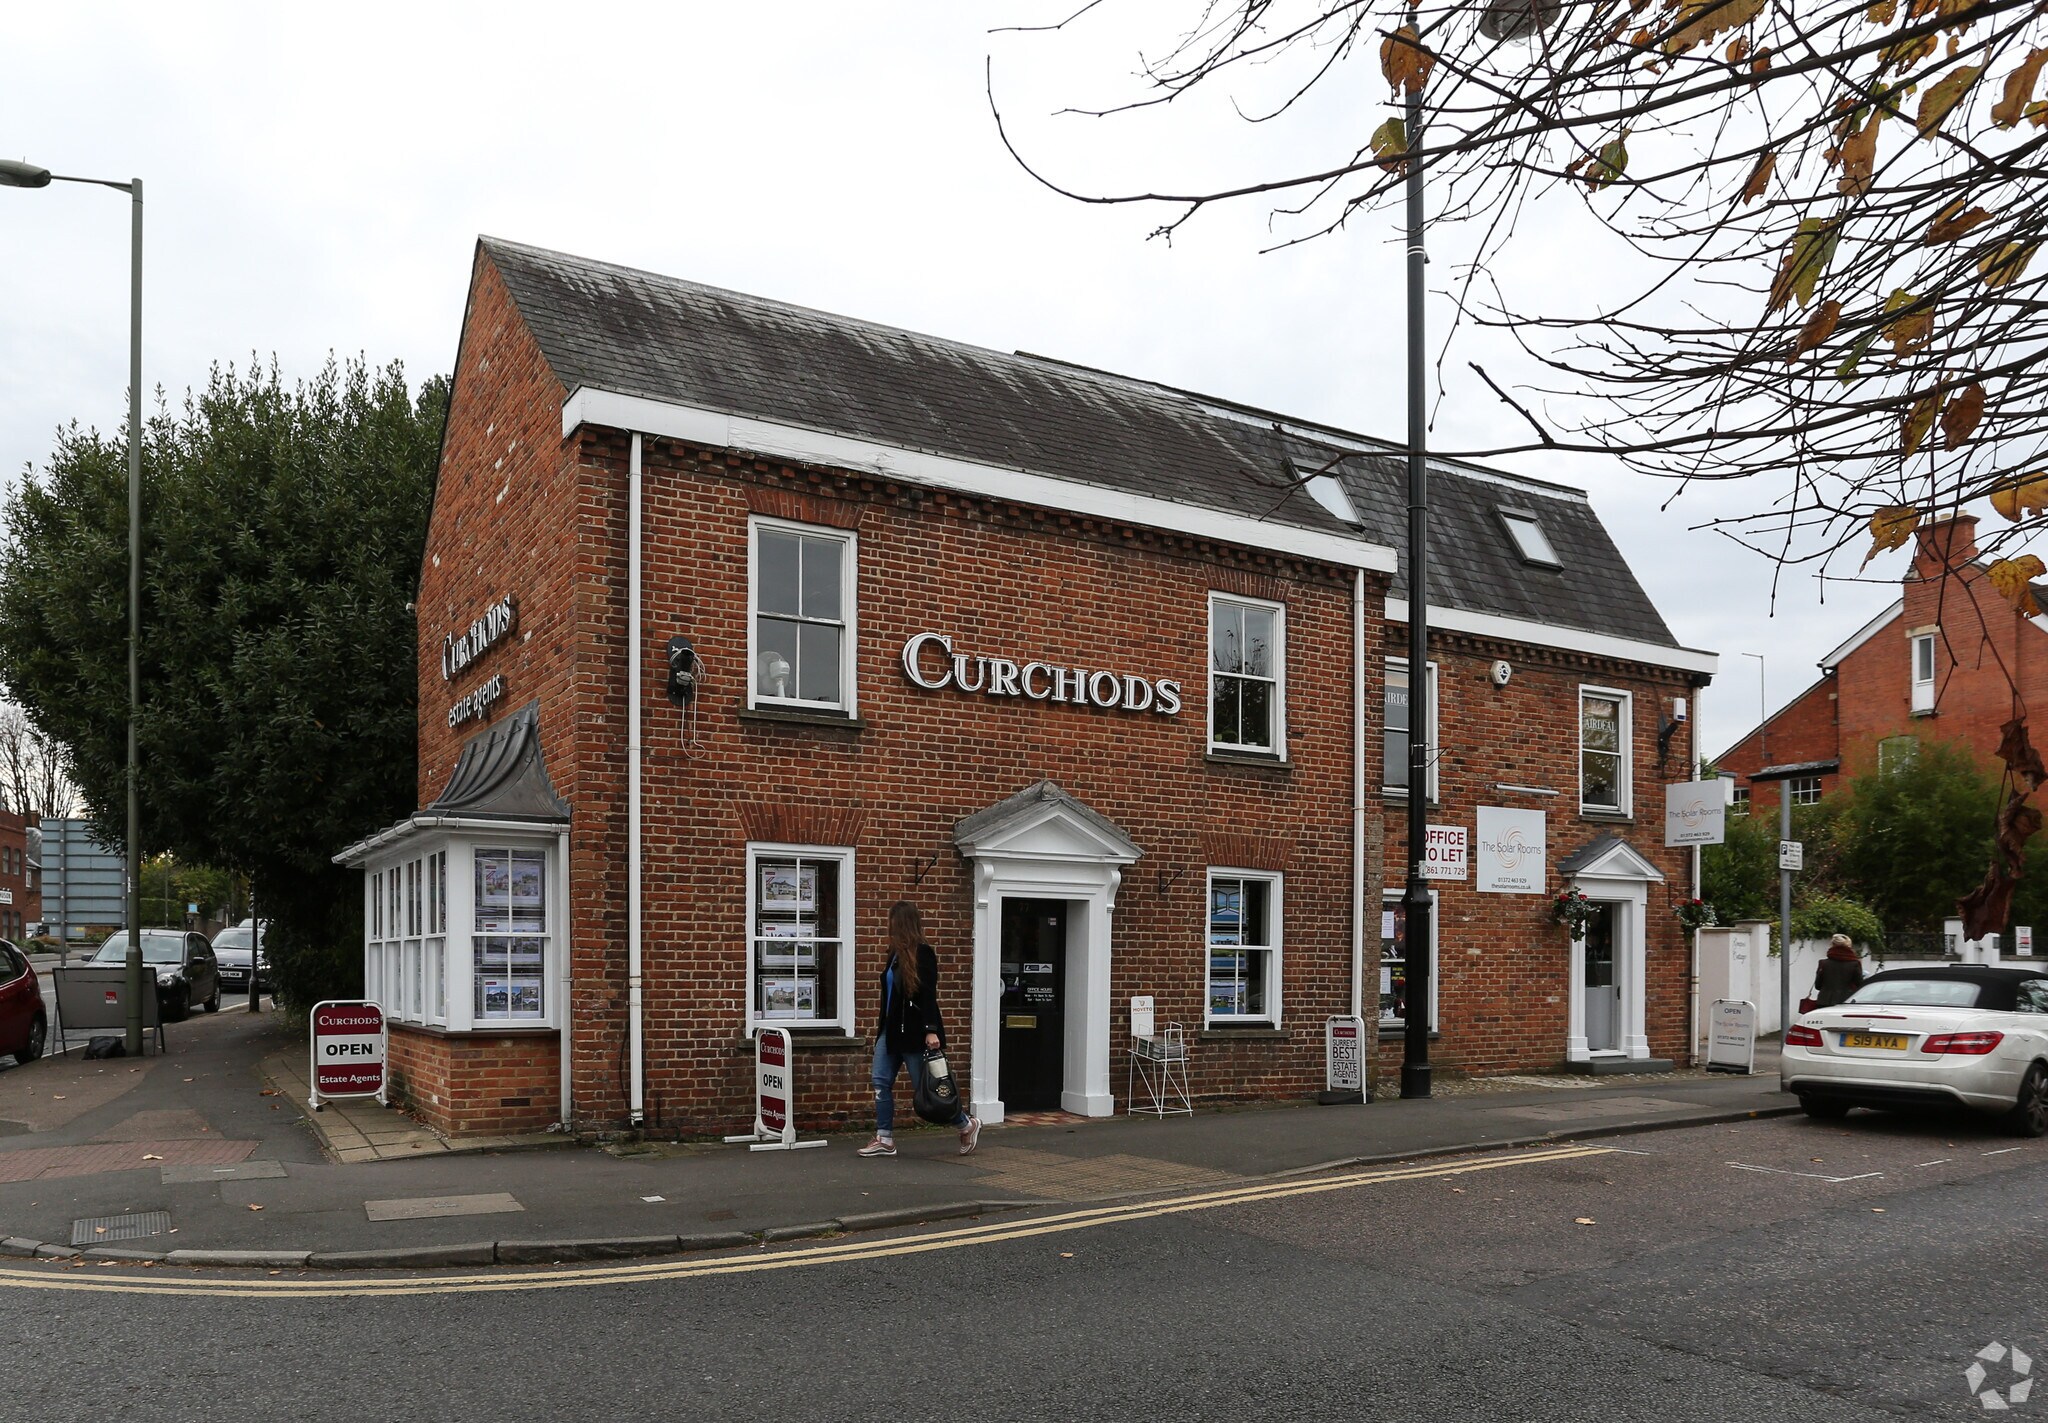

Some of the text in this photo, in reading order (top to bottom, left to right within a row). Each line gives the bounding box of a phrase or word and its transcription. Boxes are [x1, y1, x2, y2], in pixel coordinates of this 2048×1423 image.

[902, 632, 1181, 715] CURCHODS
[448, 673, 500, 727] estate agents
[1482, 841, 1542, 854] The Solar Rooms
[1425, 847, 1463, 862] O LET
[1440, 866, 1452, 874] 771
[1454, 868, 1465, 876] 729
[320, 1015, 379, 1026] CURCHODS
[1875, 1037, 1898, 1048] AYA
[326, 1044, 372, 1056] OPEN
[1333, 1047, 1356, 1059] BEST
[1333, 1062, 1357, 1072] ESTATE
[350, 1074, 380, 1084] Agents
[1333, 1070, 1357, 1078] AGENTS
[763, 1074, 782, 1089] OPEN
[762, 1106, 772, 1117] Estate
